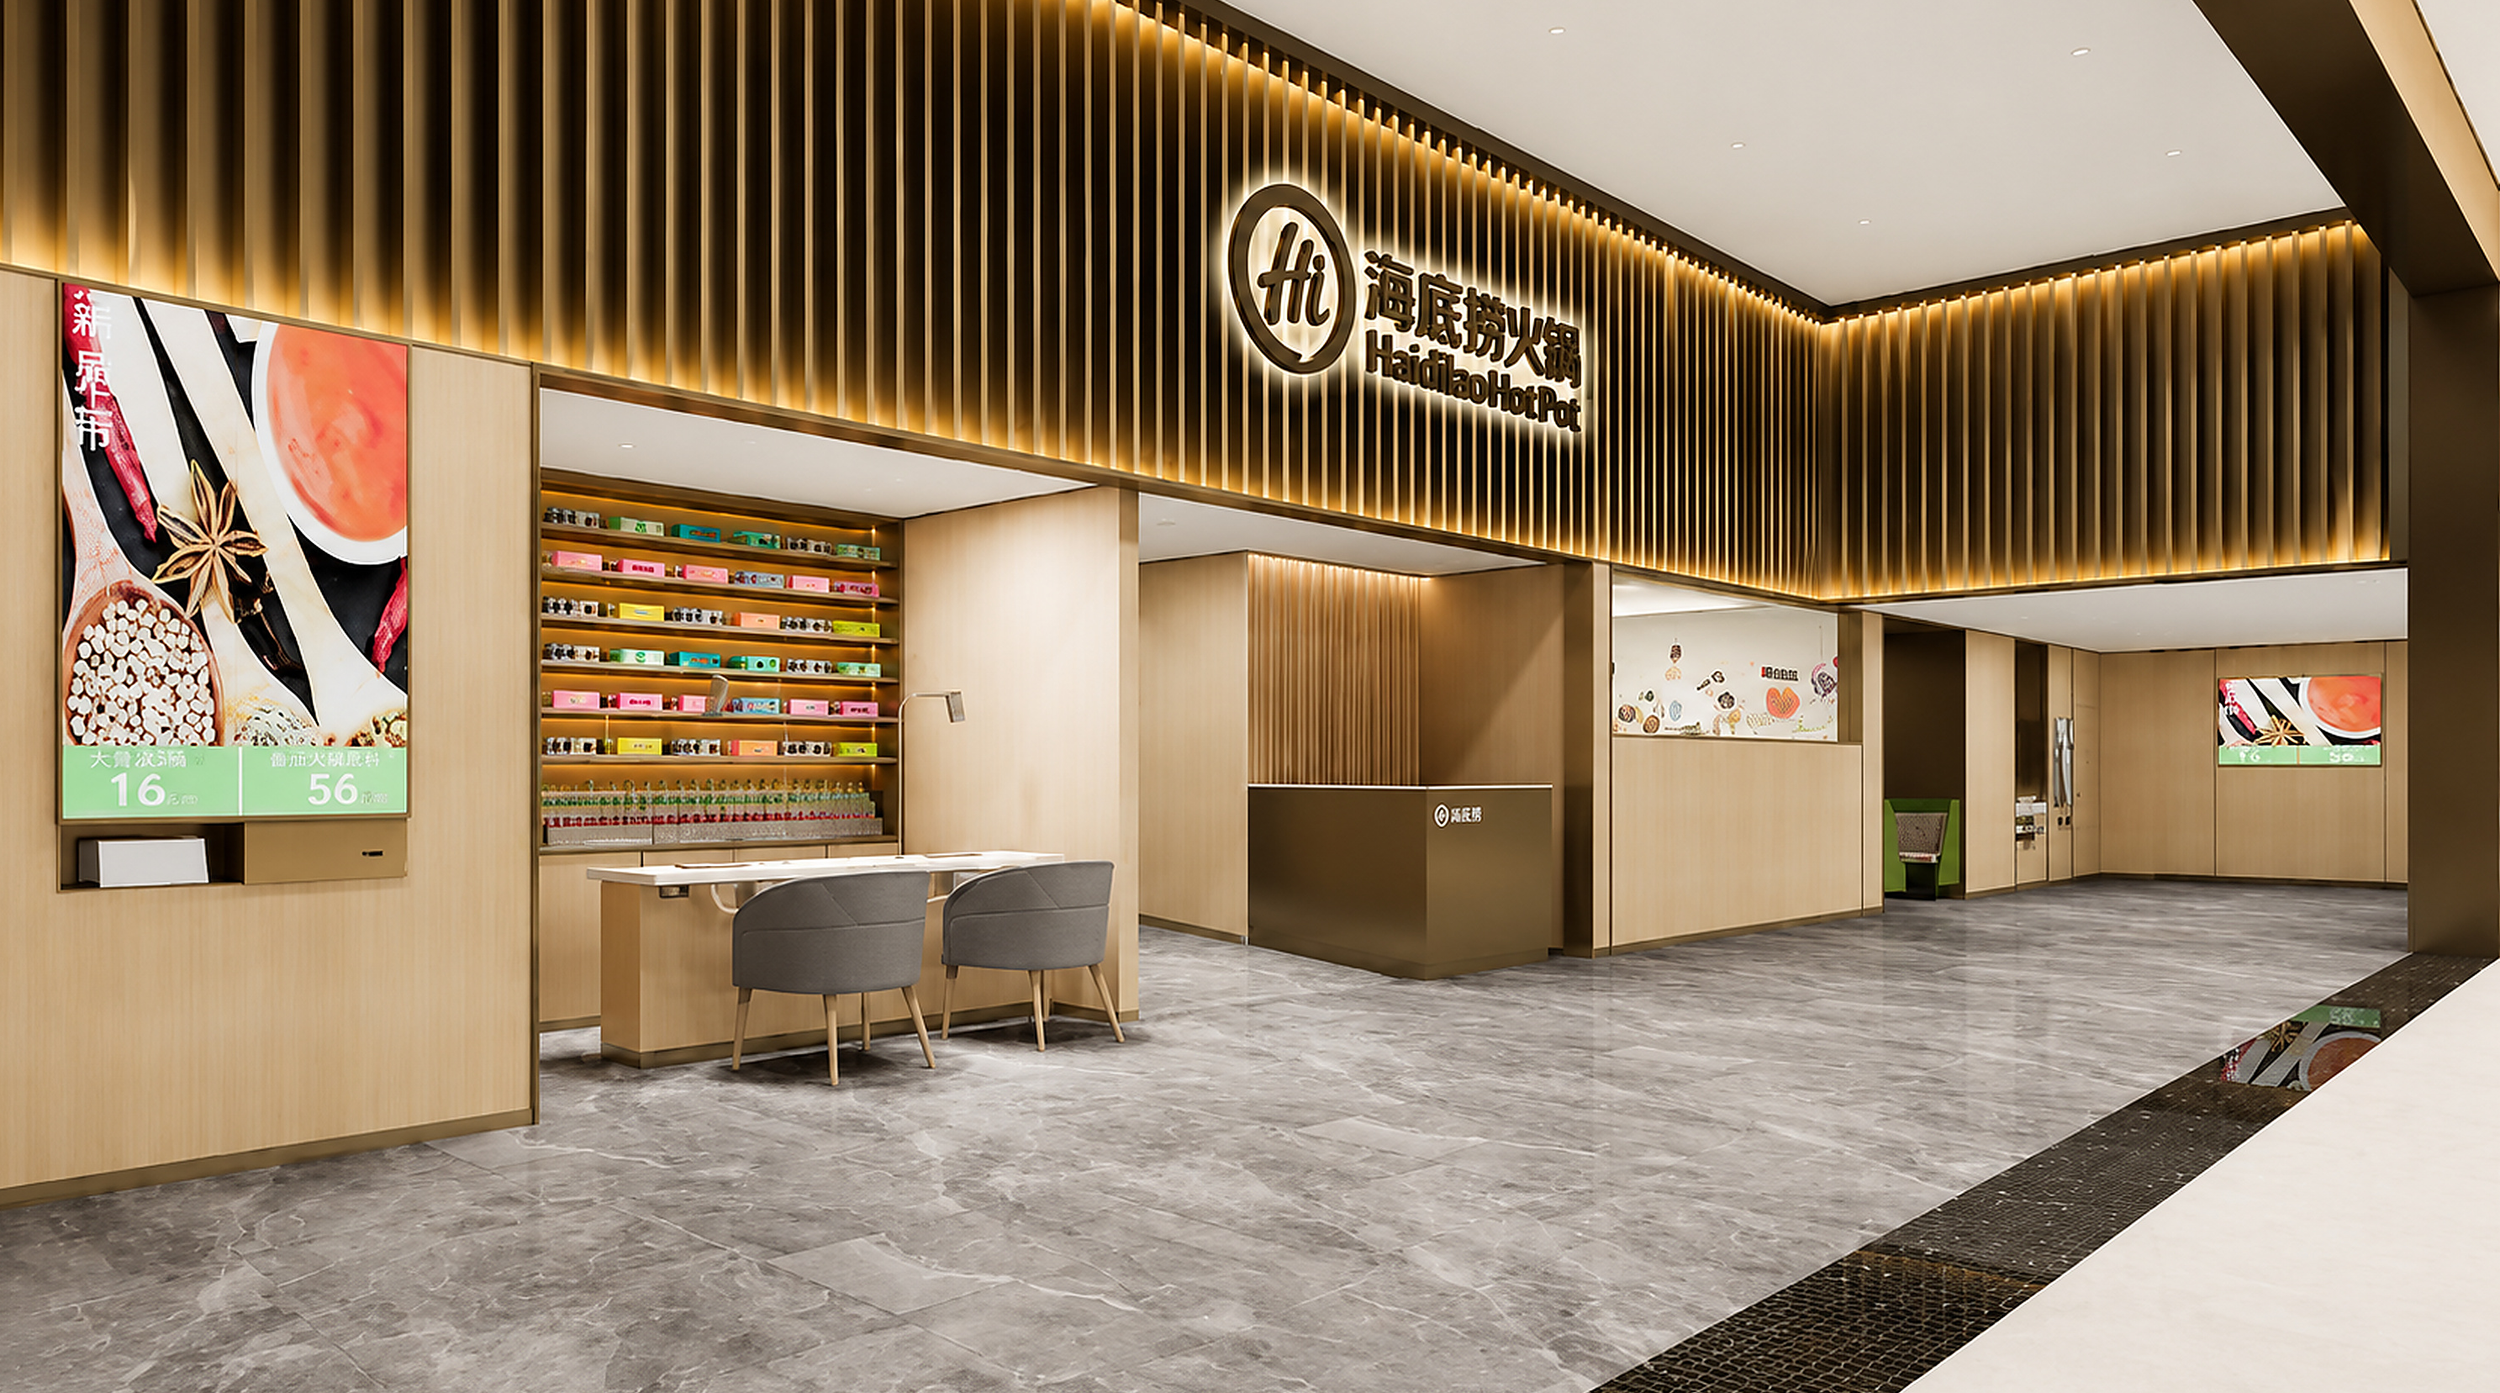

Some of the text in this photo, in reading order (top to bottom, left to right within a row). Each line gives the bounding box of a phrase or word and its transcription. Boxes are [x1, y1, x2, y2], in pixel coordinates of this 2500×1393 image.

[1257, 221, 1331, 327] Hi
[110, 772, 166, 807] 16
[307, 773, 358, 806] 56
